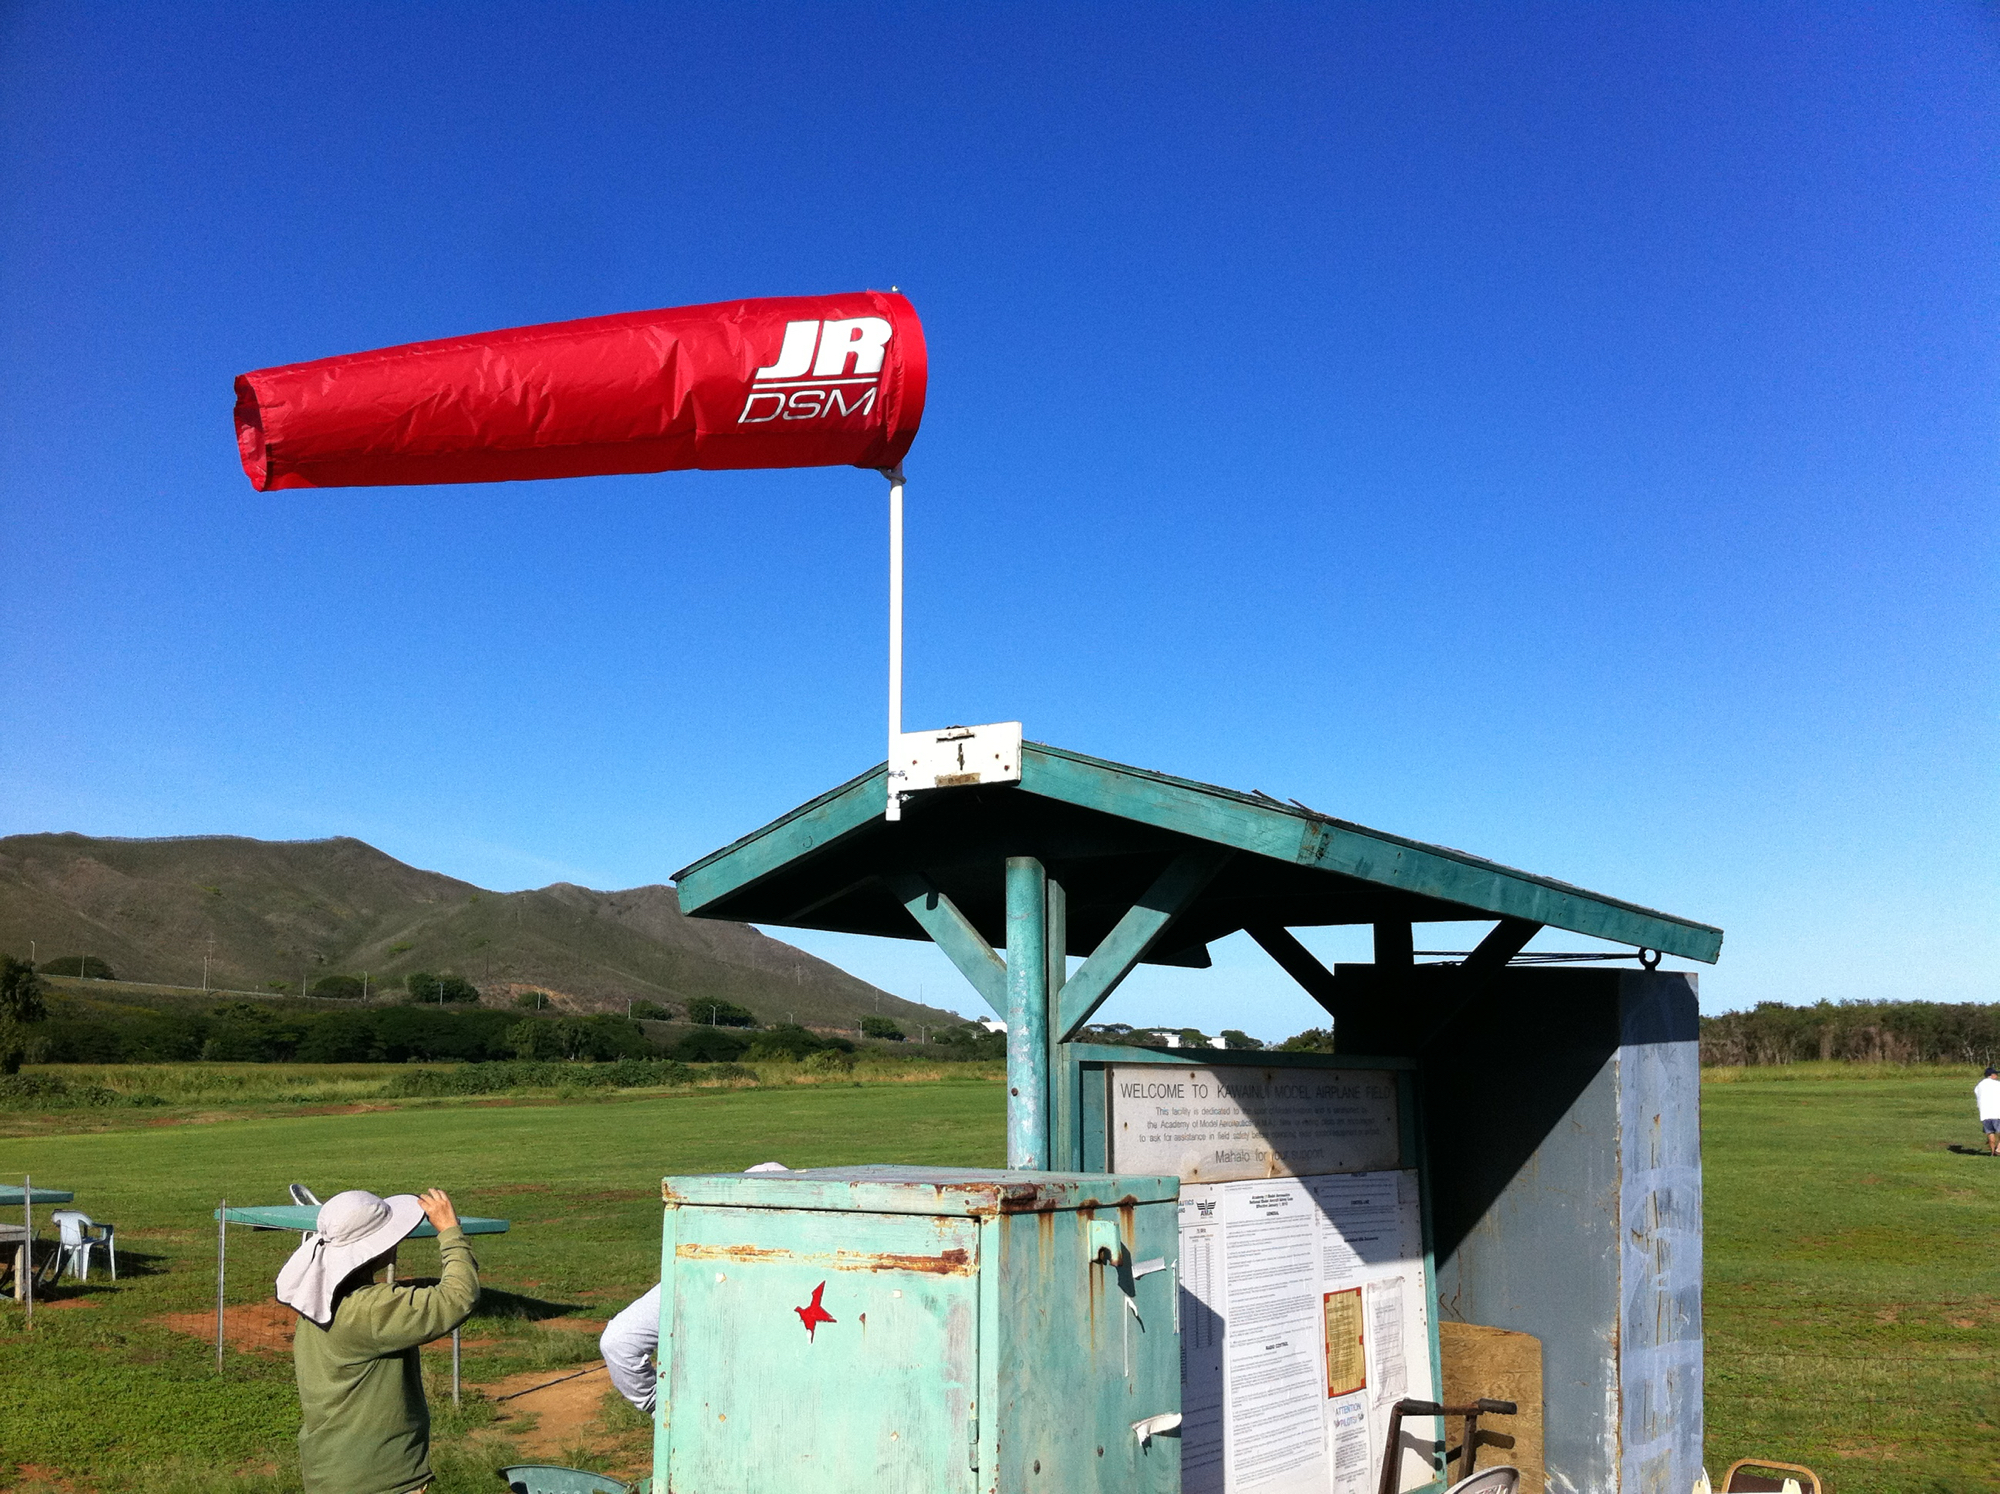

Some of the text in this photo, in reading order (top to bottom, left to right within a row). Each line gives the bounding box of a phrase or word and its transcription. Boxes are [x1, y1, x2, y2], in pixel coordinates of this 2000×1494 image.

[755, 316, 893, 379] JR
[738, 387, 877, 424] DSM
[1120, 1083, 1391, 1099] WELCOME TO KAWAINUI MODEL AIRPLANE FIELD
[1156, 1106, 1169, 1116] This
[1172, 1107, 1191, 1117] facility
[1193, 1107, 1199, 1116] is
[1201, 1106, 1231, 1116] dedicated
[1233, 1107, 1240, 1116] to
[1147, 1120, 1158, 1129] the
[1160, 1120, 1190, 1130] Academy
[1192, 1120, 1199, 1129] of
[1200, 1119, 1218, 1129] Model
[1218, 1119, 1252, 1128] Aeronautics
[1139, 1134, 1147, 1143] to
[1149, 1133, 1162, 1143] ask
[1164, 1133, 1172, 1142] for
[1174, 1132, 1207, 1142] assistance
[1209, 1132, 1215, 1141] in
[1217, 1131, 1230, 1141] field
[1232, 1130, 1250, 1141] safety
[1215, 1150, 1250, 1164] Mahalo
[1254, 1148, 1268, 1162] for
